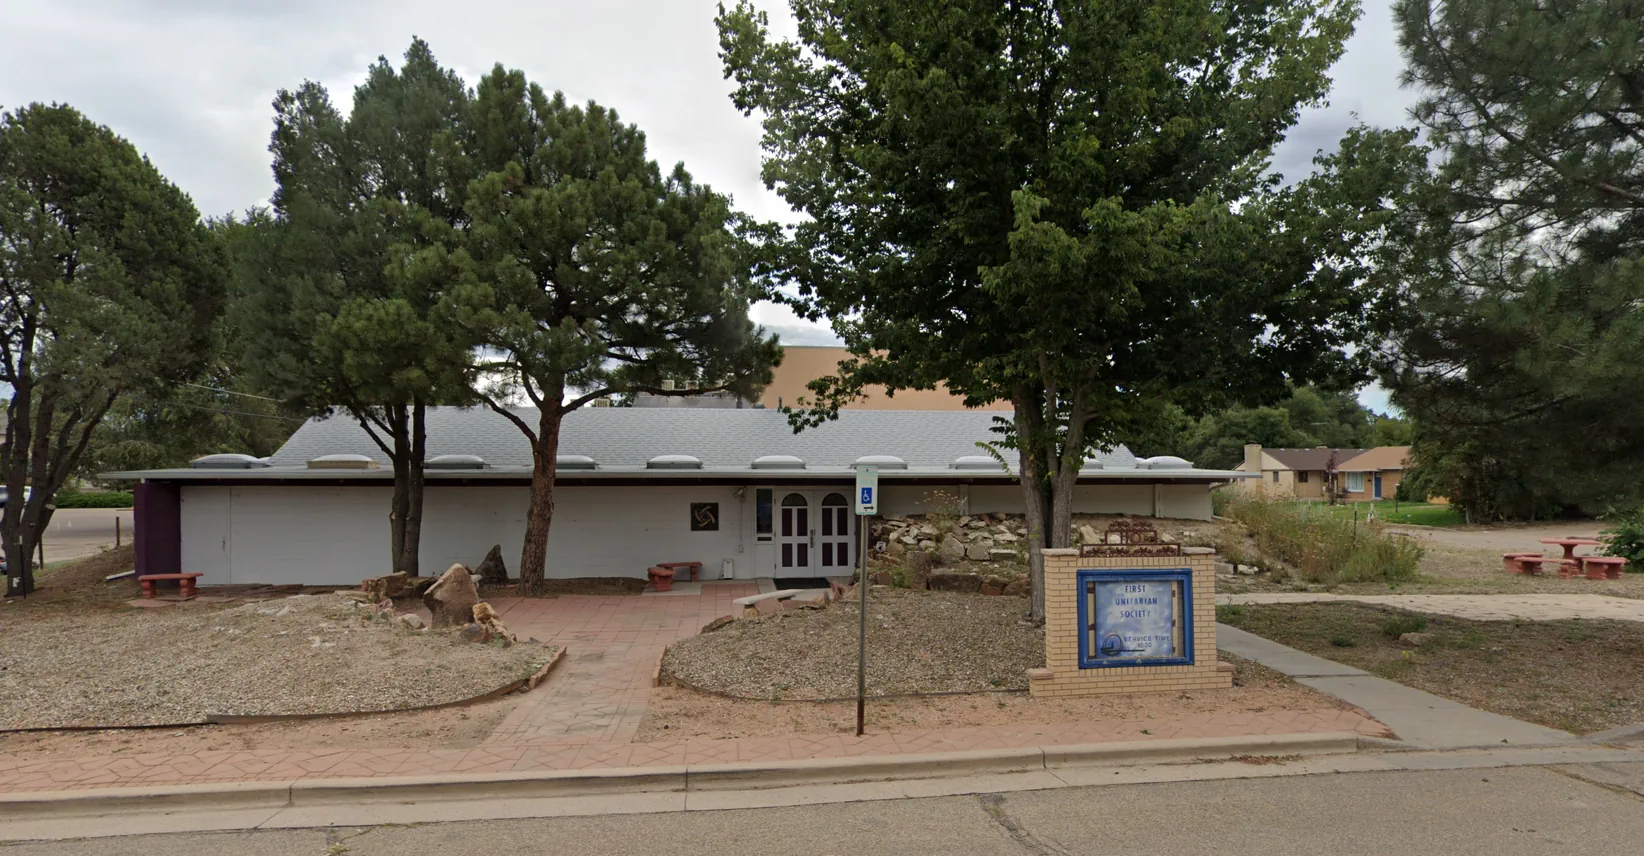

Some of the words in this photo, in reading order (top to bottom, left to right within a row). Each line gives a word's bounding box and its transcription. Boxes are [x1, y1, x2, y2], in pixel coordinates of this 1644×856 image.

[1125, 585, 1146, 593] FIRST
[1116, 597, 1157, 606] UNITARIAN
[1120, 610, 1151, 618] SOCIETY
